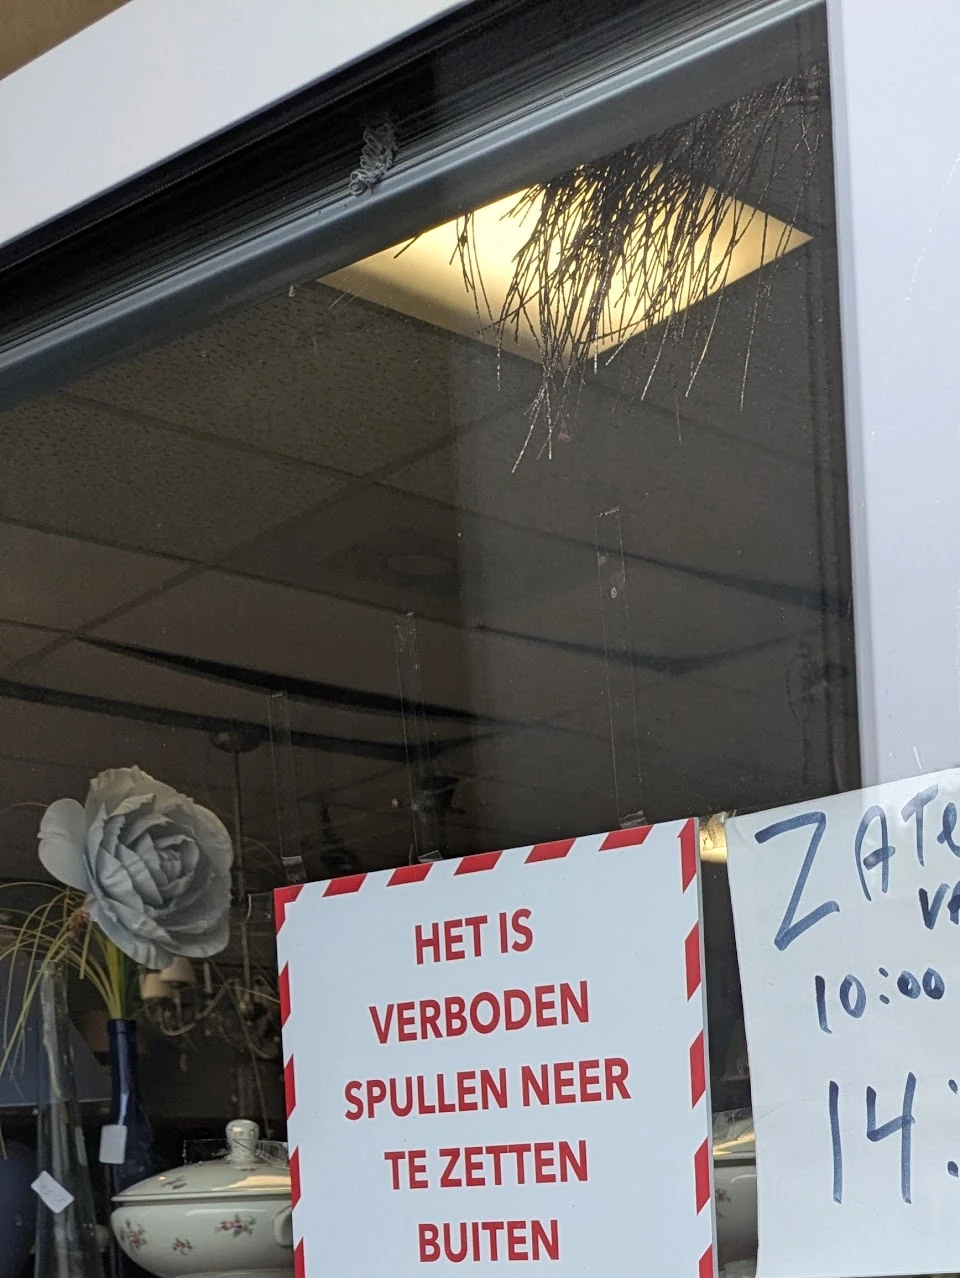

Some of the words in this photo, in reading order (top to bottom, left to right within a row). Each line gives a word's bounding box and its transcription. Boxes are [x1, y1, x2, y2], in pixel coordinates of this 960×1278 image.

[415, 914, 488, 966] HET
[499, 907, 534, 954] IS
[368, 980, 590, 1044] VERBODEN
[815, 966, 946, 1034] 10:00
[344, 1068, 508, 1121] SPULLEN
[521, 1057, 632, 1108] NEER
[384, 1147, 429, 1190] TE
[439, 1140, 588, 1189] ZETTEN
[417, 1218, 560, 1263] BUITEN
